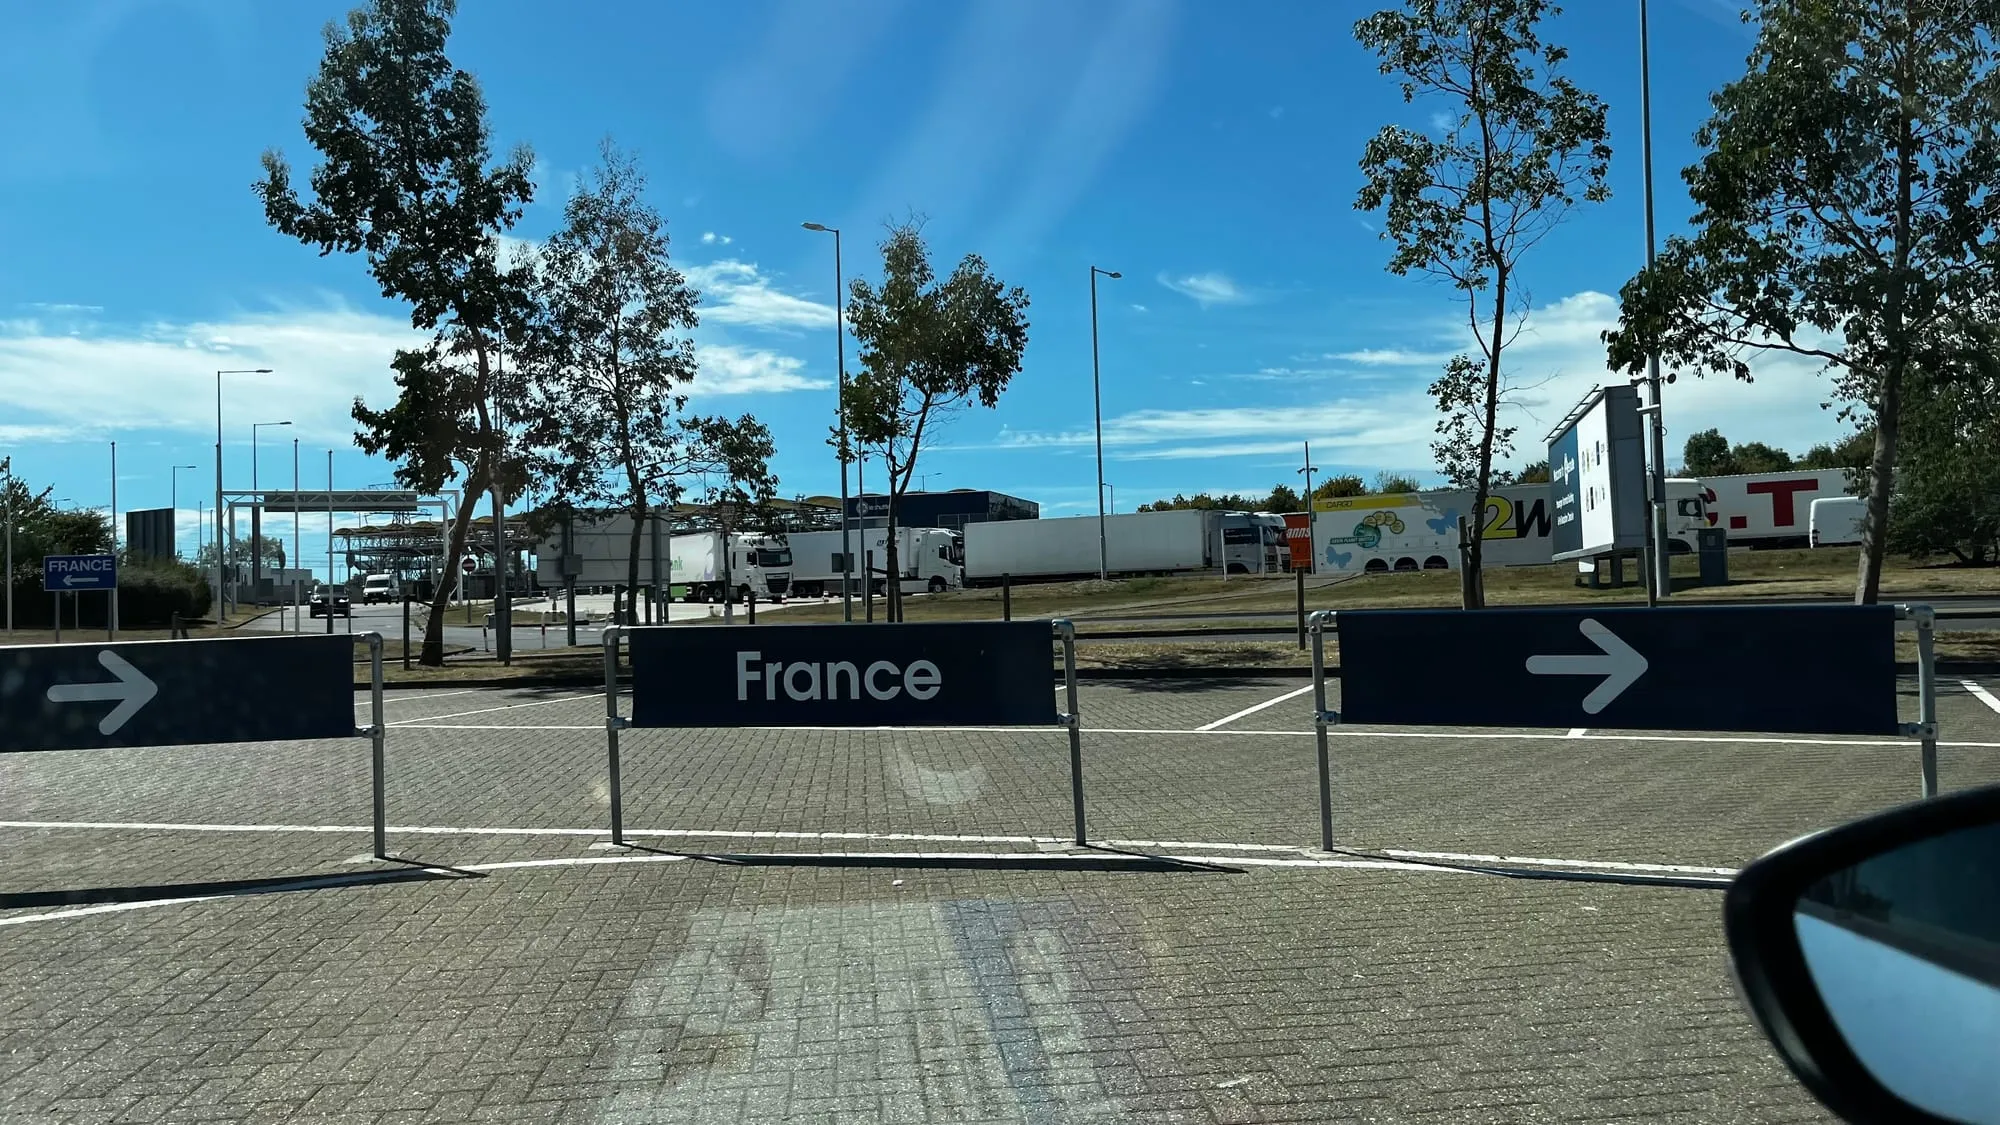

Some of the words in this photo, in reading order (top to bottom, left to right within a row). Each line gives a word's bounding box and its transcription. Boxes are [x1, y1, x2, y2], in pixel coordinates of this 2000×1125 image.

[1326, 500, 1353, 509] CARGO
[48, 559, 113, 572] FRANCE
[736, 651, 942, 701] France
